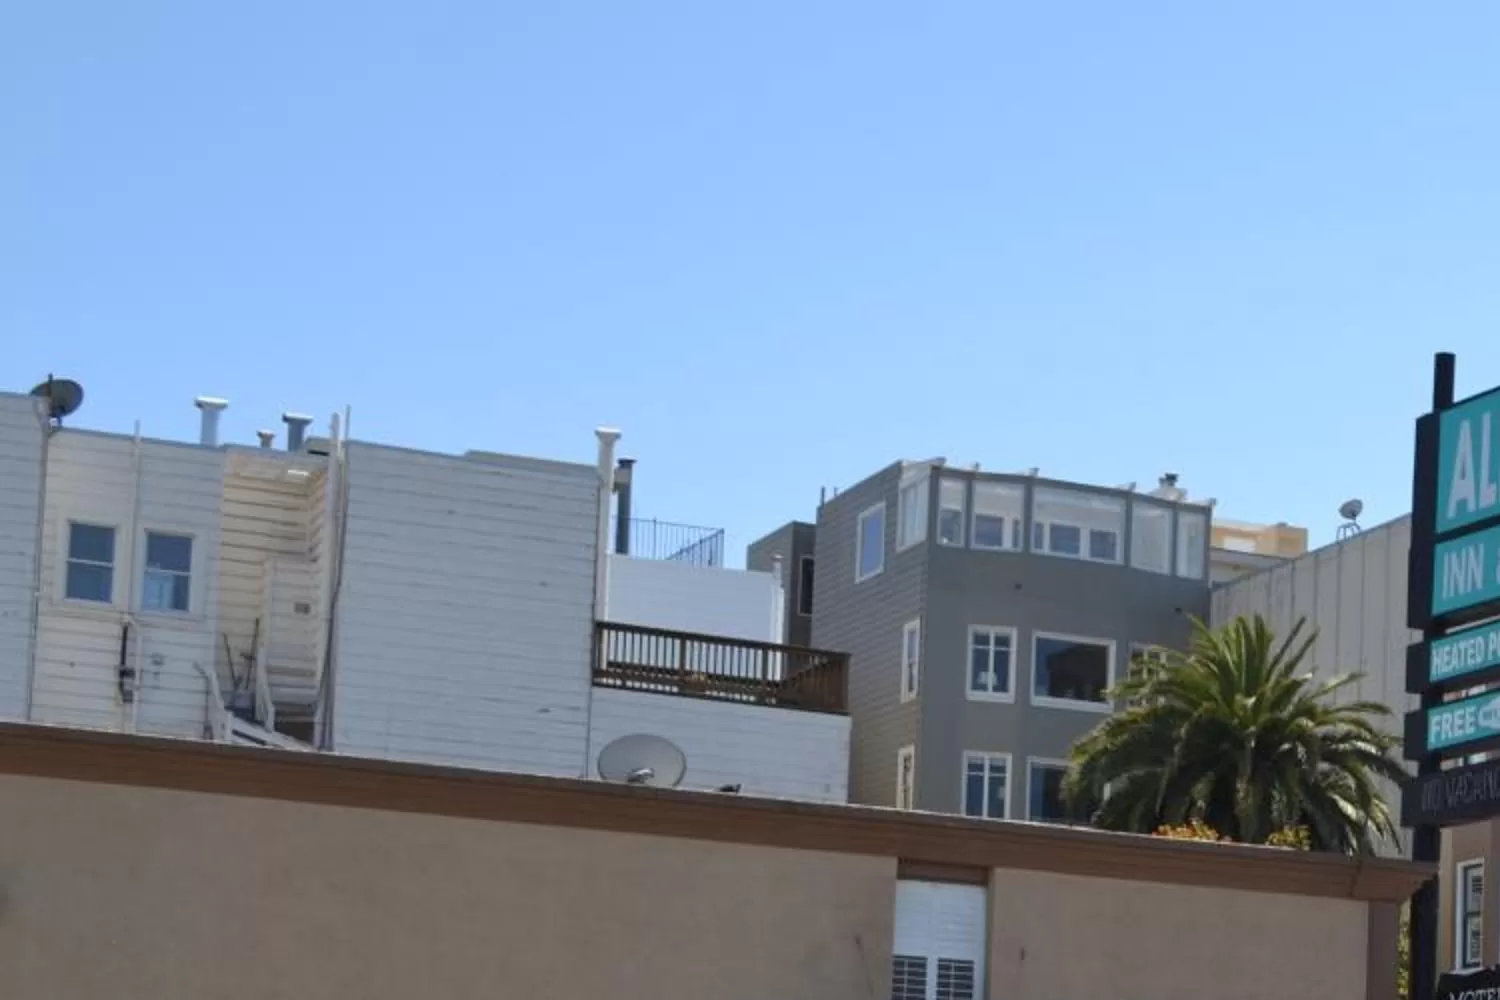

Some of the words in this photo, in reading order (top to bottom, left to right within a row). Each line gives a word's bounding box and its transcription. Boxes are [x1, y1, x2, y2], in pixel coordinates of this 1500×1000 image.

[1442, 543, 1484, 599] INN
[1431, 636, 1485, 678] HEATED
[1430, 704, 1477, 742] FREE
